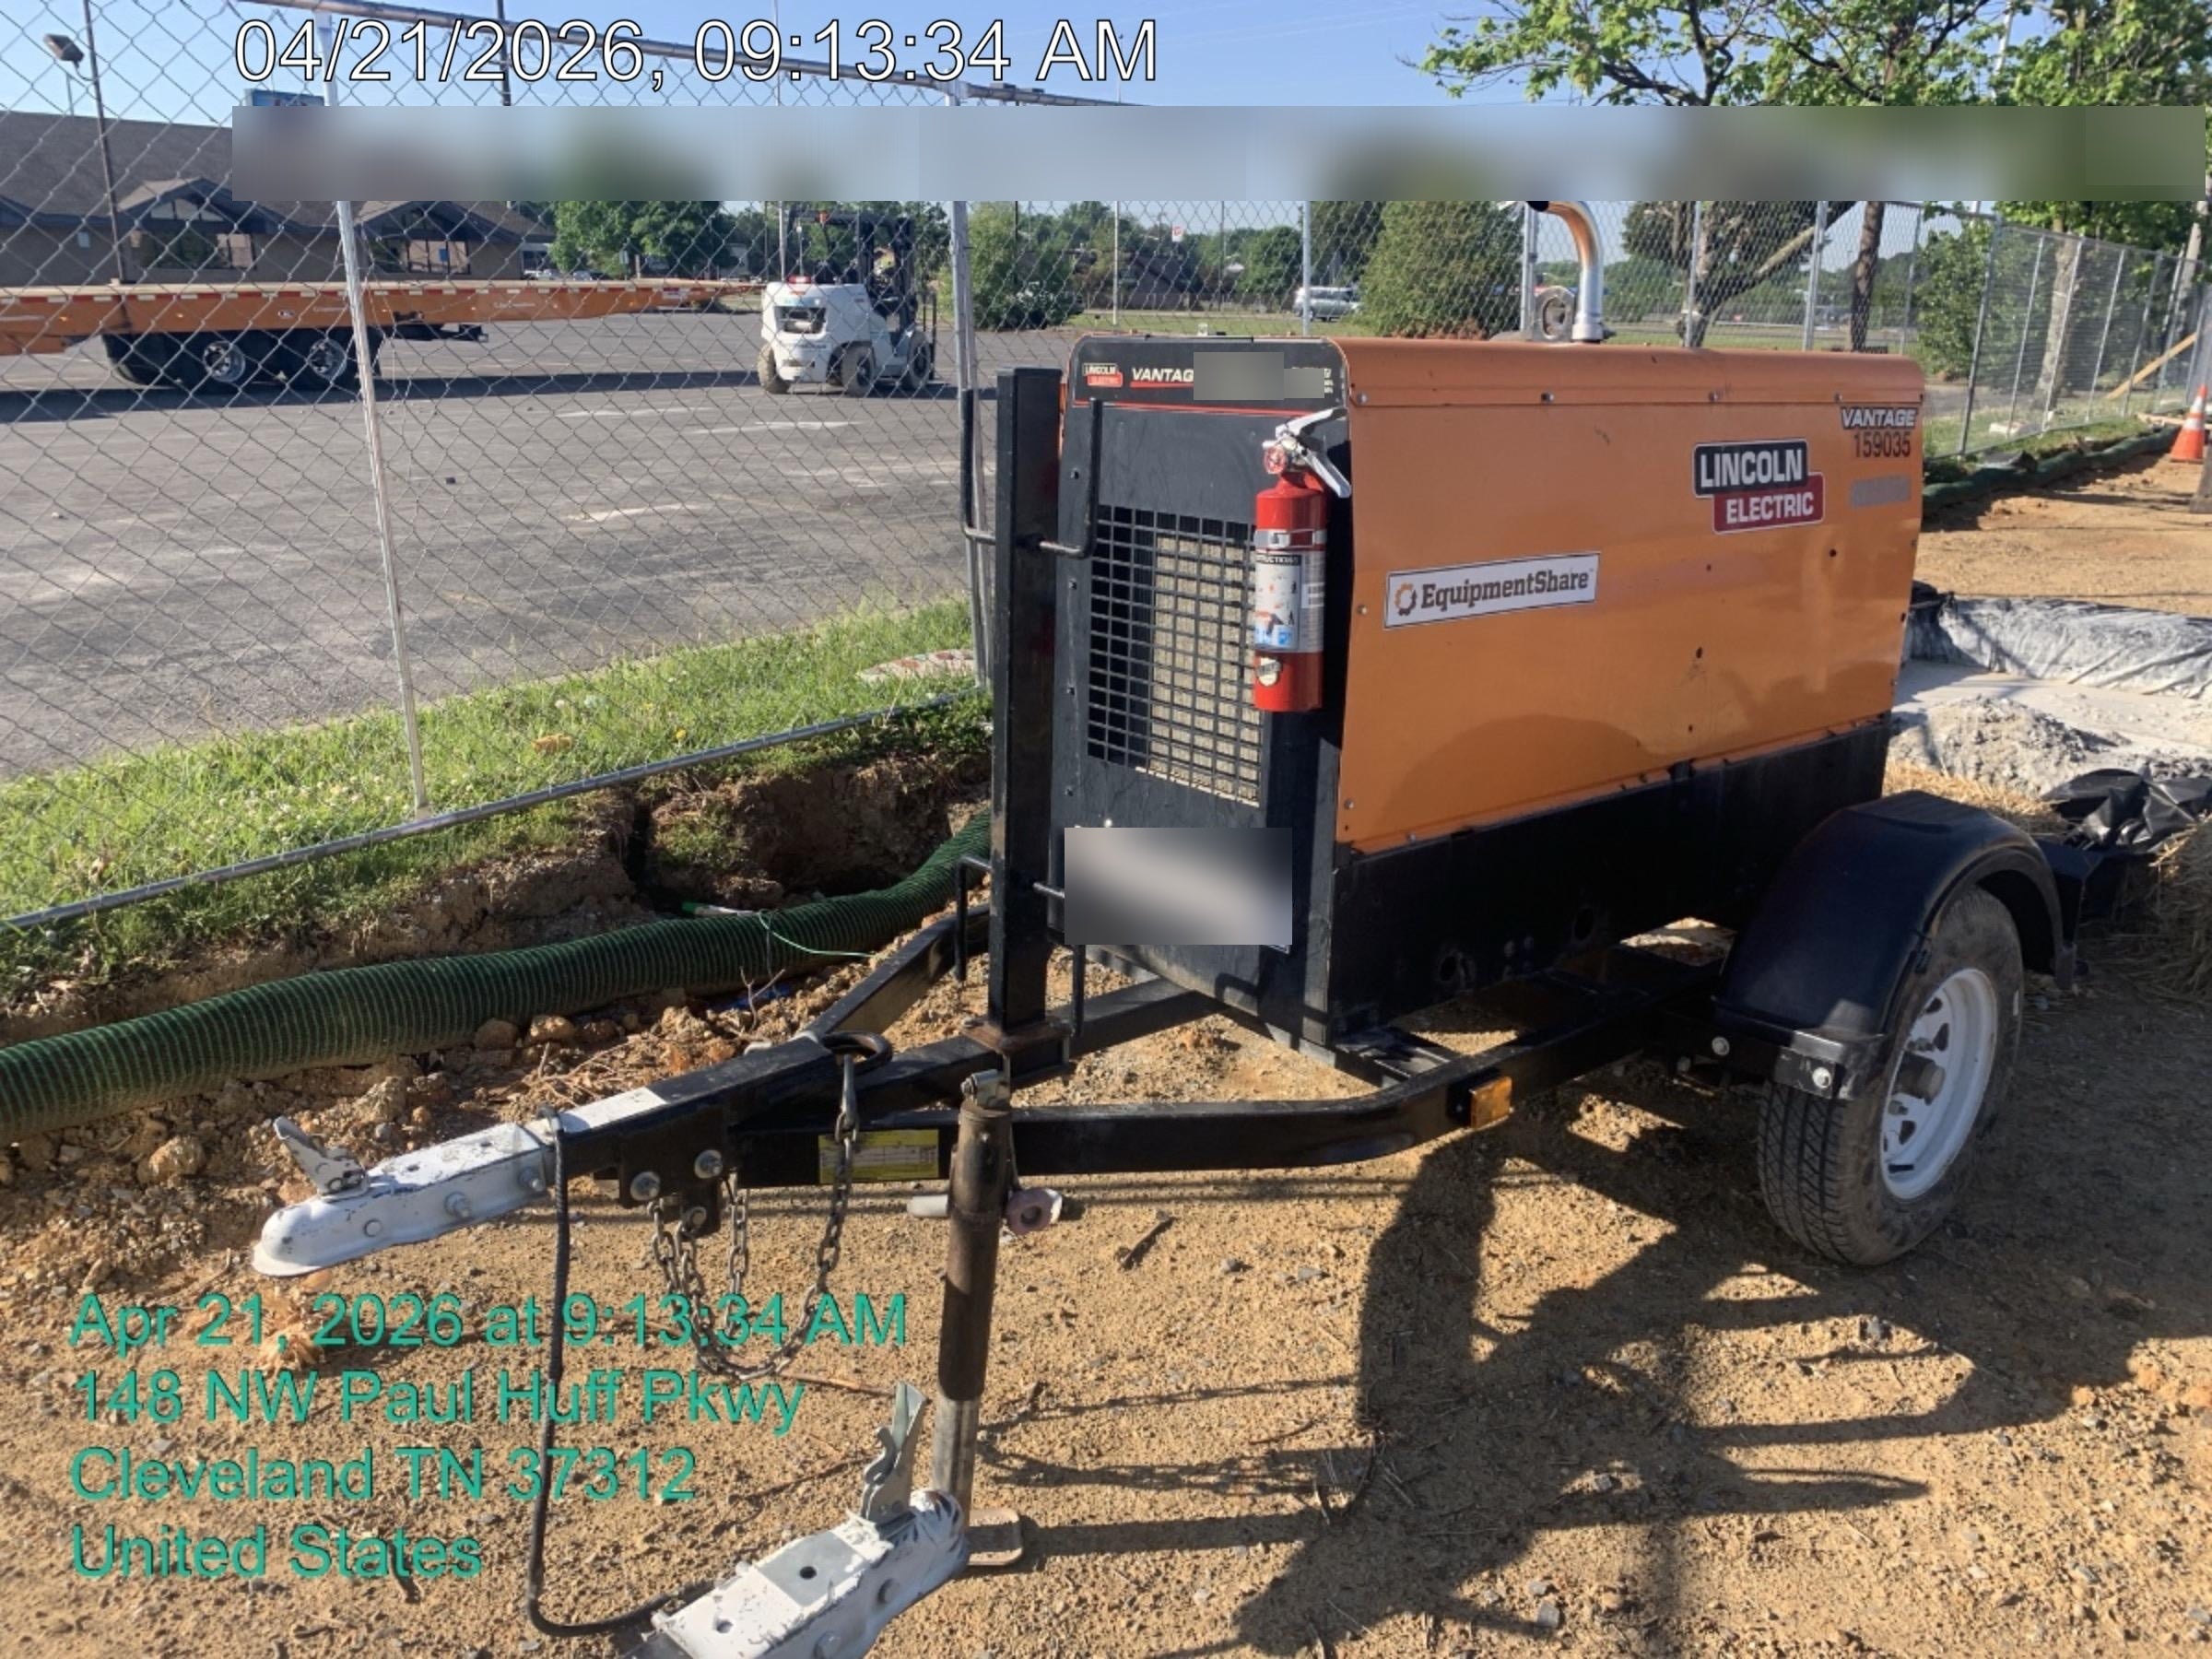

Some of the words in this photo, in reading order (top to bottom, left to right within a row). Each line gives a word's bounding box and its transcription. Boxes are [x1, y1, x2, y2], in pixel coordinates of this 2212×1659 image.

[1132, 367, 1194, 382] VANTAG
[1841, 406, 1918, 429] VANTAGE
[1853, 430, 1912, 458] 159035
[1700, 449, 1803, 488] LINCOLN
[1725, 491, 1815, 525] ELECTRIC
[1420, 569, 1589, 612] EquipmentShare
